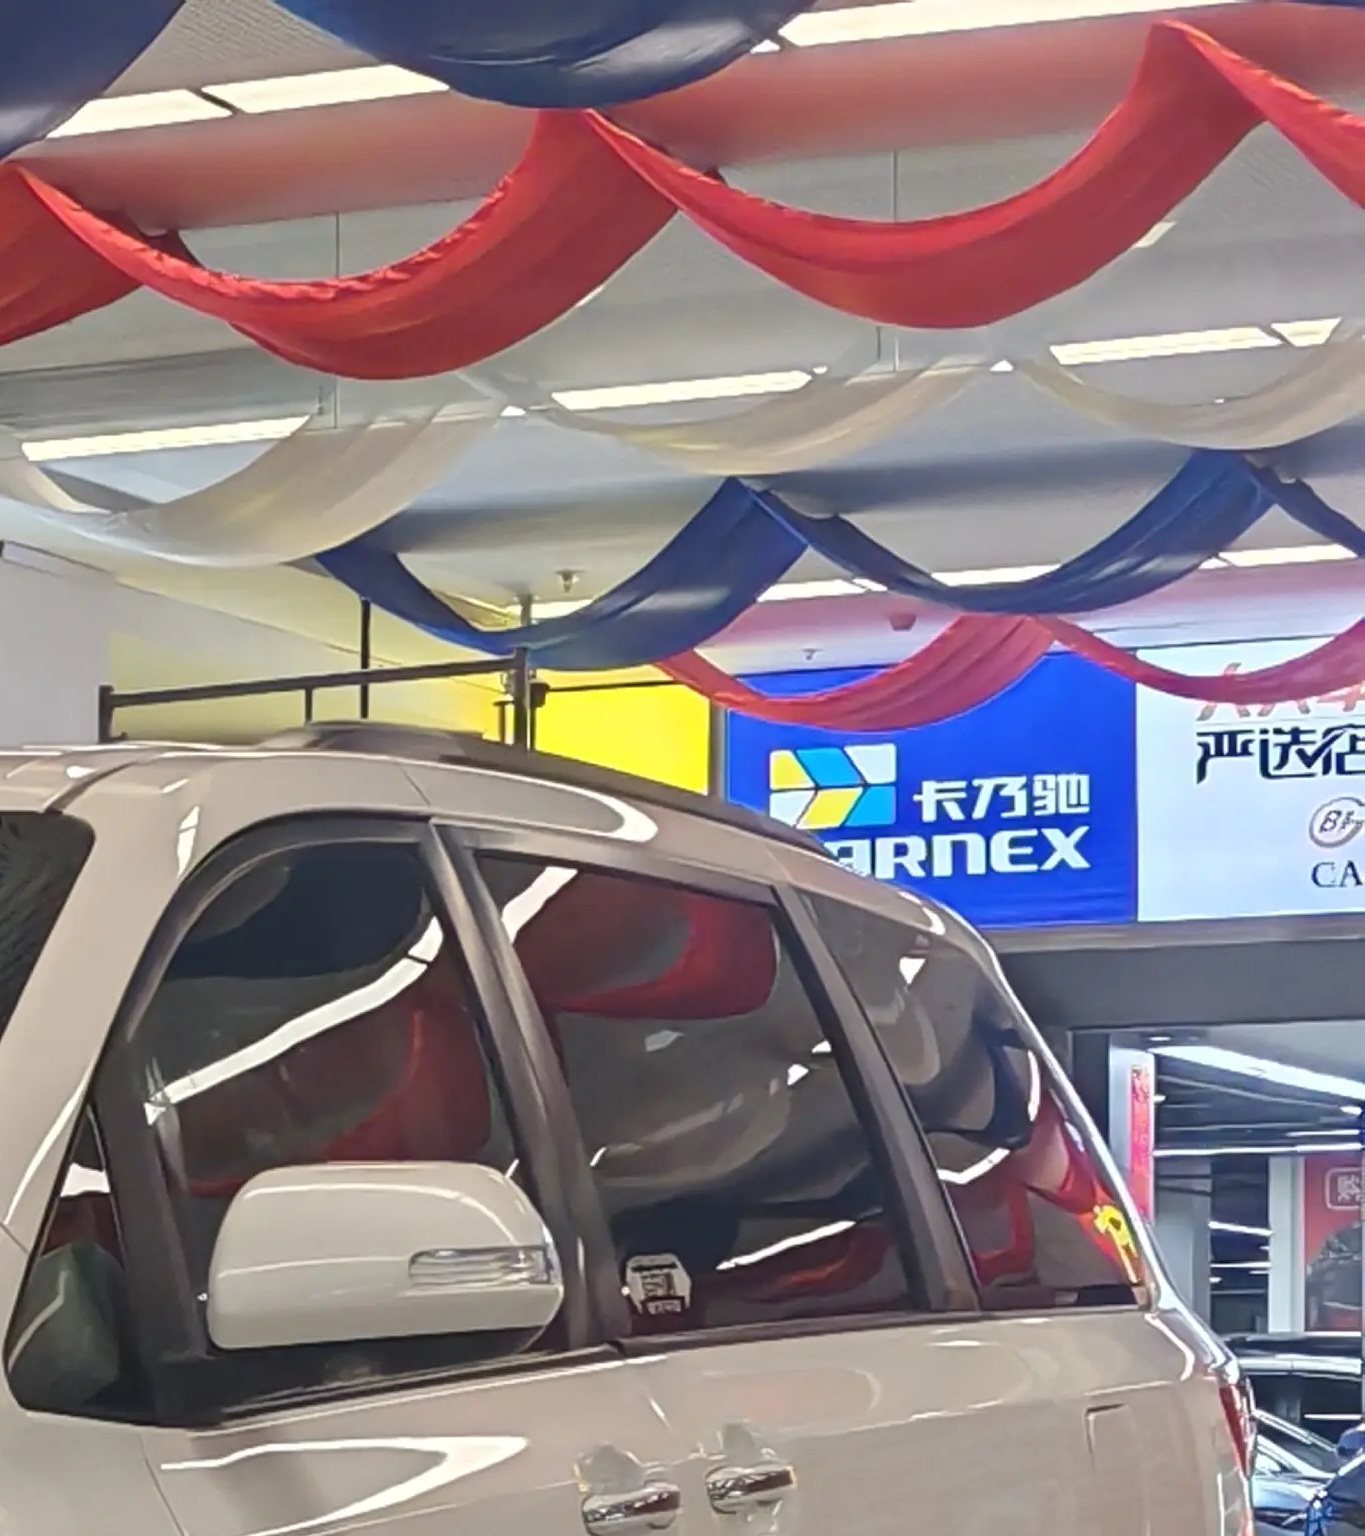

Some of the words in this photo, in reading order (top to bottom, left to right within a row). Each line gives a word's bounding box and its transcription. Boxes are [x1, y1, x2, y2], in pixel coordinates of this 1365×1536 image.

[1196, 724, 1365, 784] 严选店
[913, 773, 1091, 823] 卡乃驰
[822, 826, 1092, 880] ARNEX
